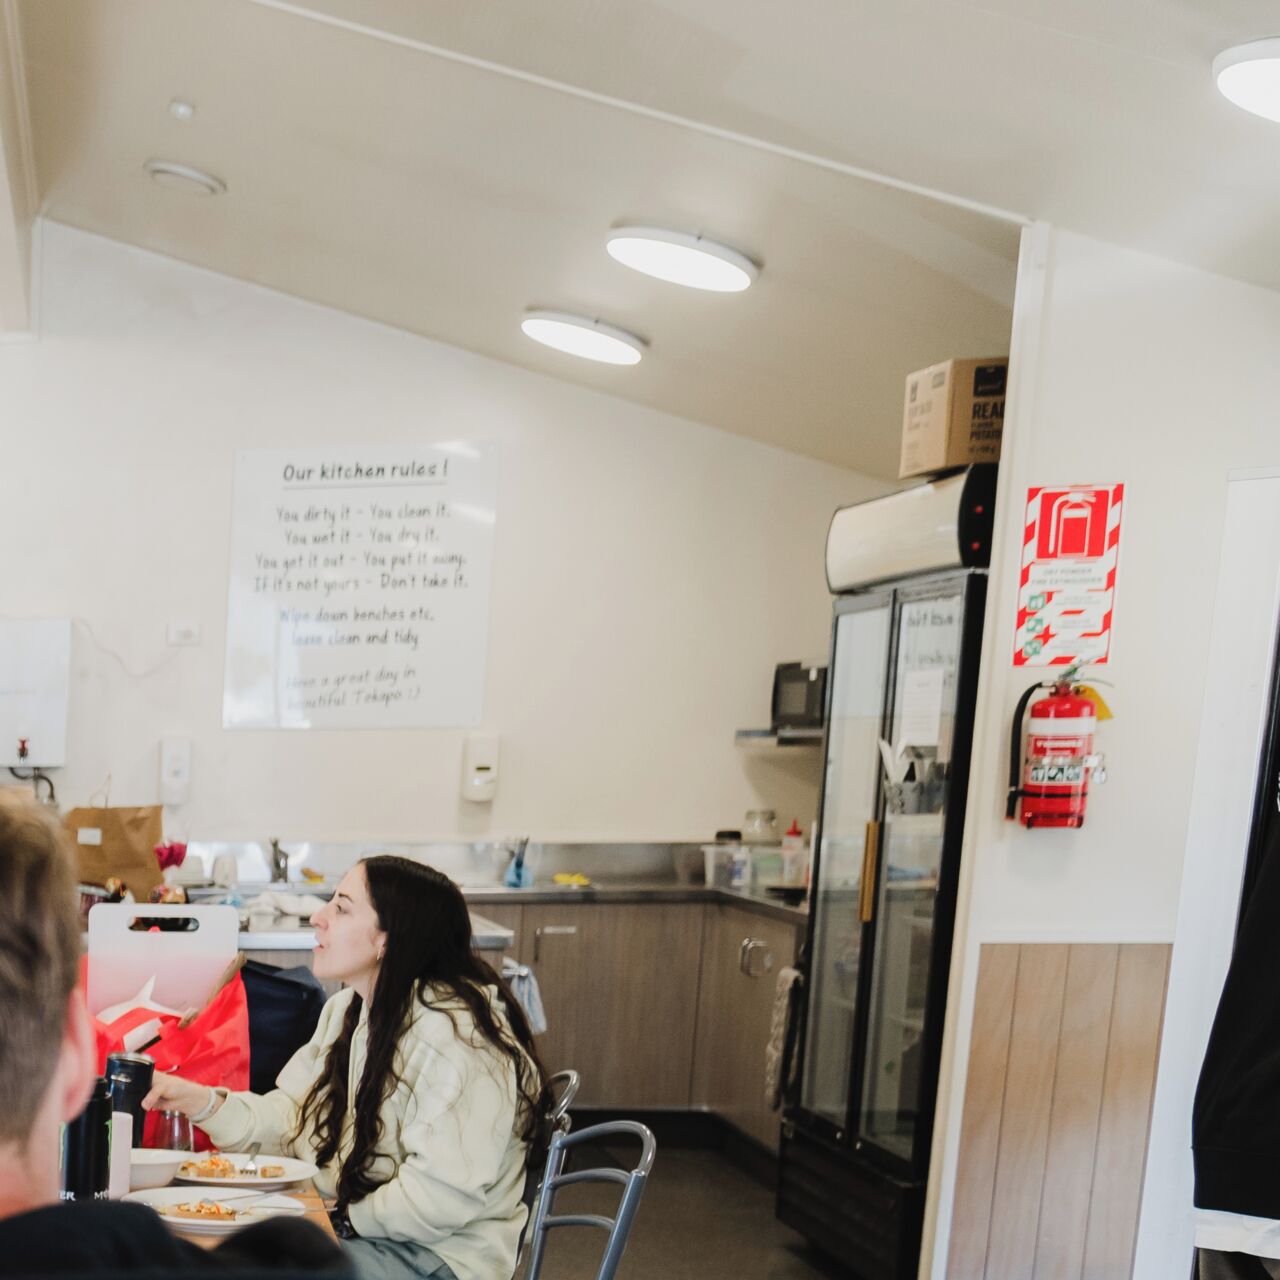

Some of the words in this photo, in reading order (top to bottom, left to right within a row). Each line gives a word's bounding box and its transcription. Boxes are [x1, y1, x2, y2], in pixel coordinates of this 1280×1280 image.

[283, 464, 313, 482] Our
[320, 461, 385, 480] kitchen
[276, 505, 299, 522] You
[304, 505, 336, 528] dirty
[340, 504, 350, 521] it
[369, 502, 392, 519] You
[397, 501, 431, 519] clean
[285, 528, 307, 545] You
[312, 529, 335, 544] wet
[340, 528, 350, 544] it
[369, 525, 392, 543] You
[397, 524, 420, 545] dry
[255, 552, 277, 569] You
[308, 551, 318, 568] it
[323, 552, 344, 567] out
[363, 550, 385, 567] You
[391, 551, 412, 572] put
[418, 550, 427, 565] it
[254, 576, 268, 592] If
[273, 575, 291, 592] it's
[297, 576, 319, 591] not
[324, 579, 359, 597] yours
[381, 573, 416, 589] Don't
[423, 573, 448, 589] take
[315, 607, 348, 621] down
[353, 606, 404, 622] benches
[328, 630, 360, 645] clean
[366, 629, 388, 644] and
[394, 628, 418, 651] tidy
[335, 670, 370, 691] great
[375, 666, 398, 685] day
